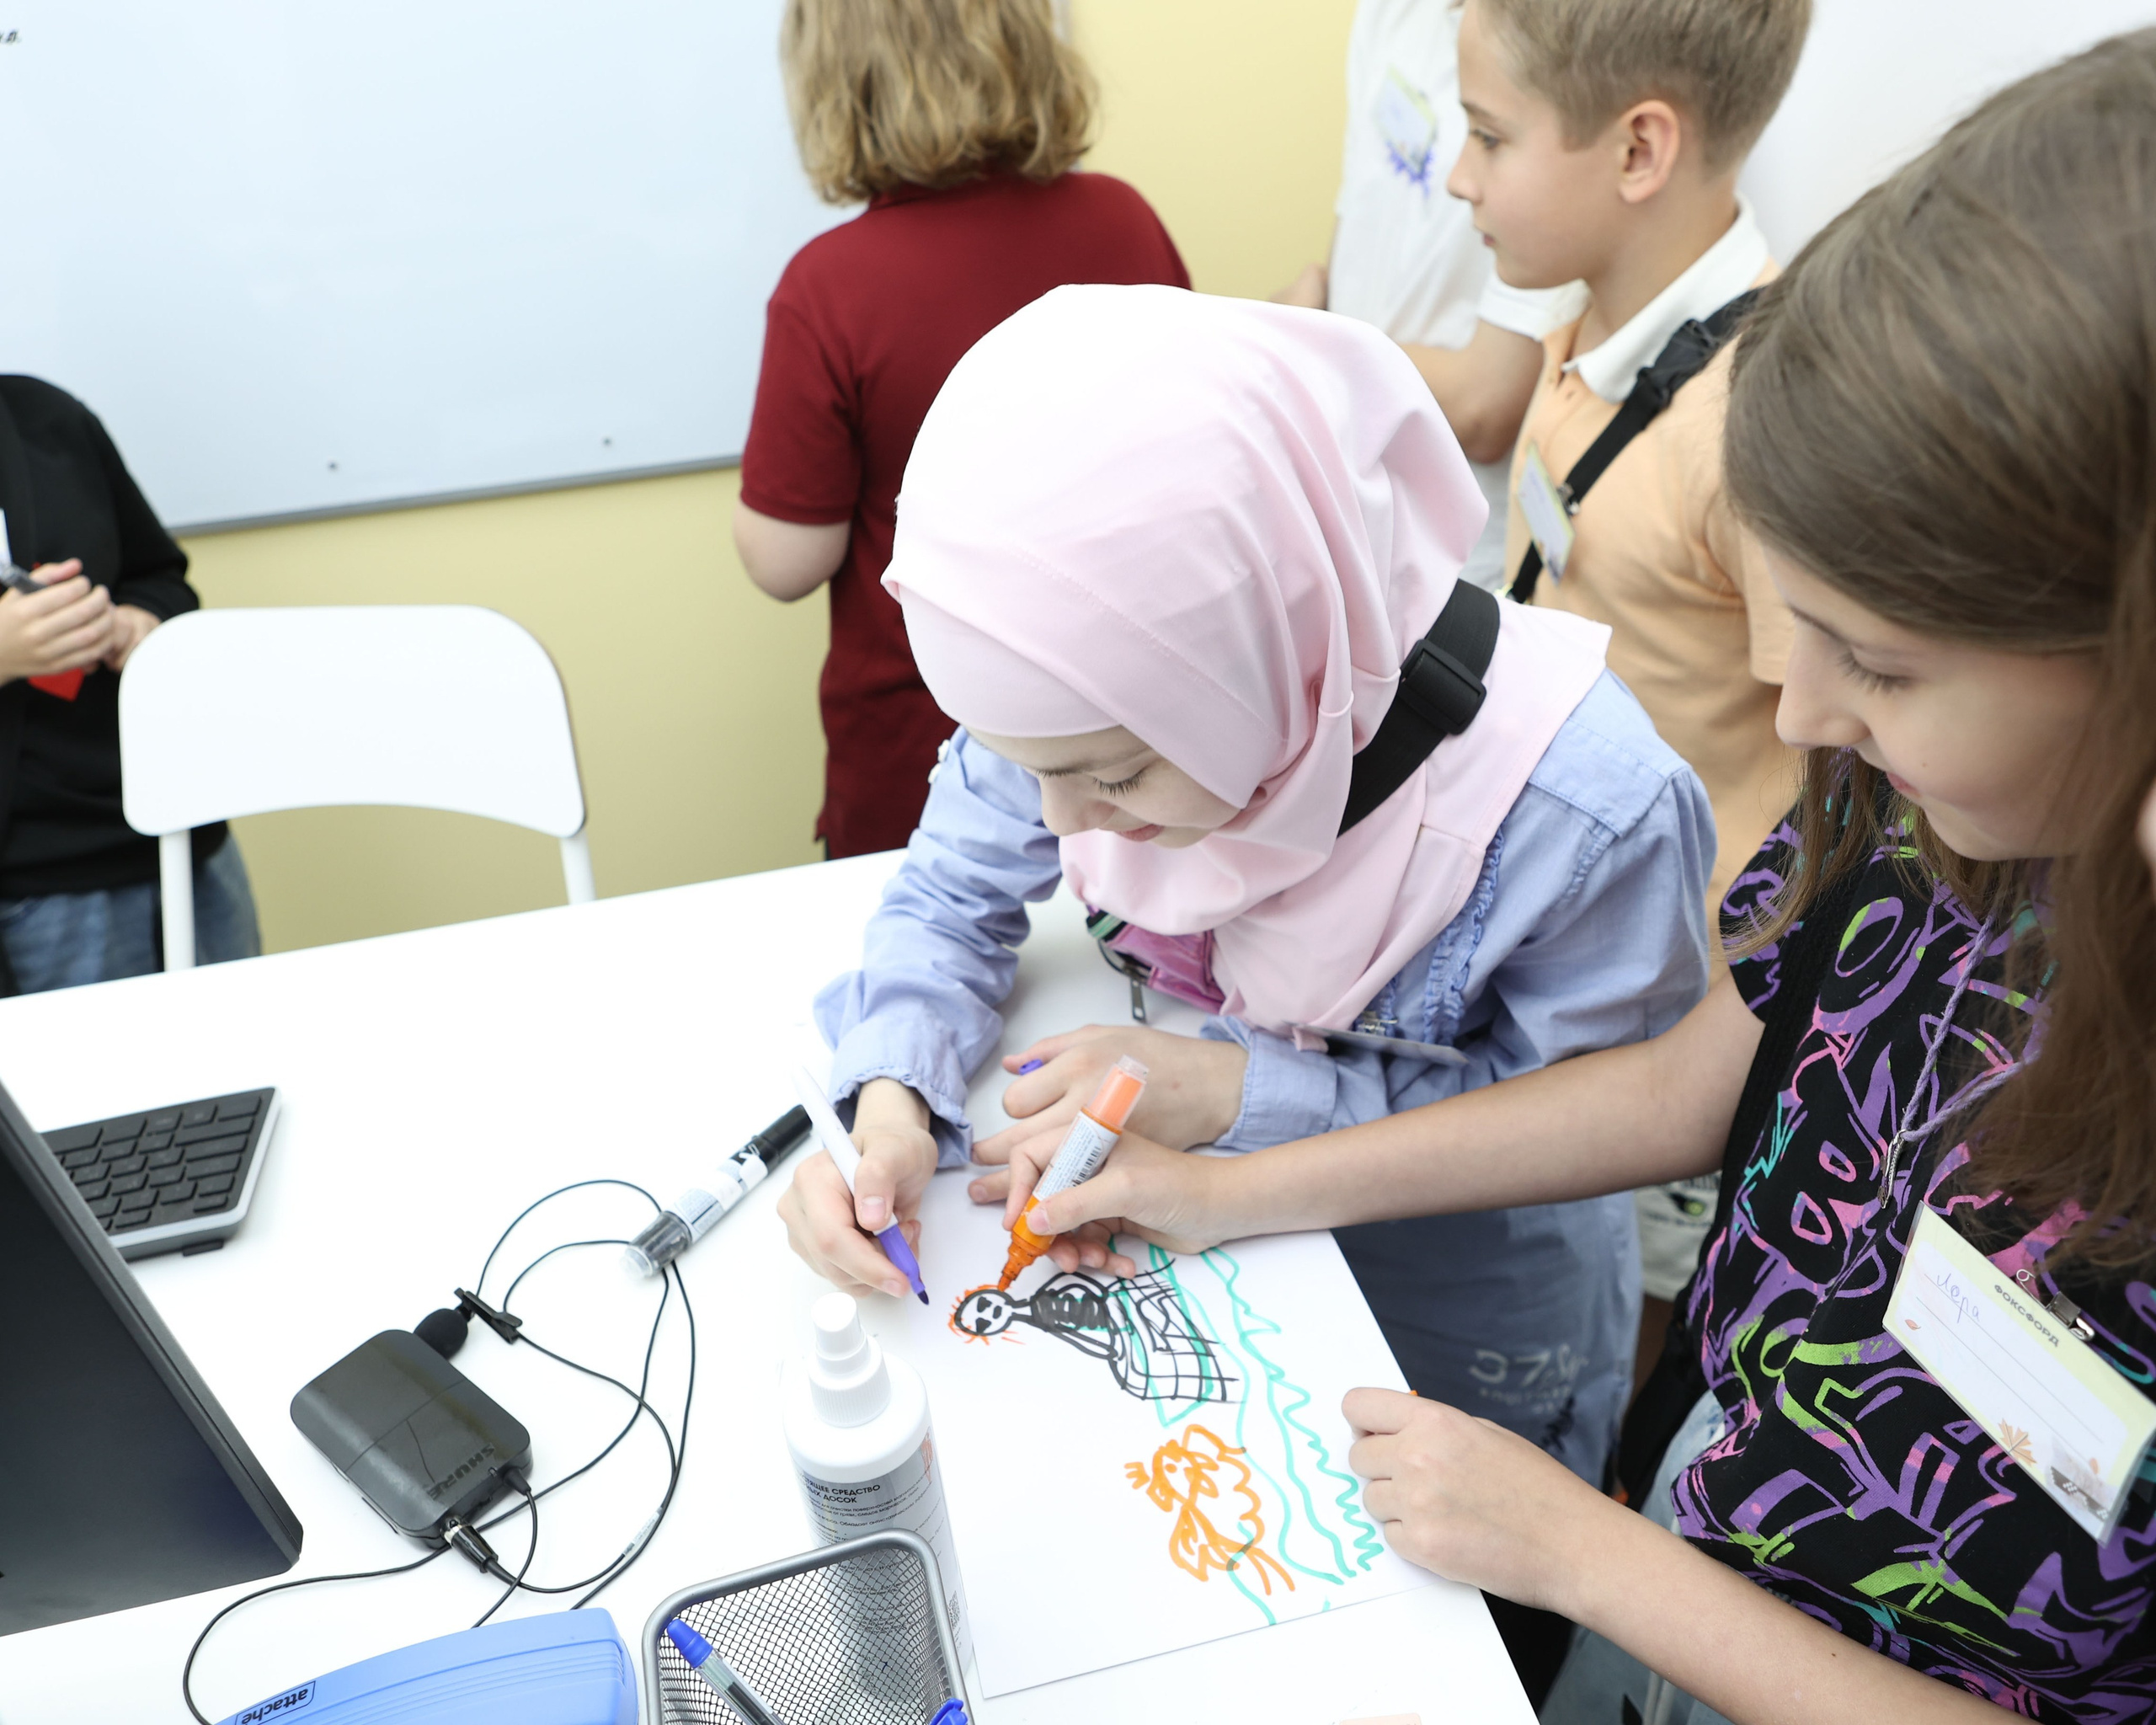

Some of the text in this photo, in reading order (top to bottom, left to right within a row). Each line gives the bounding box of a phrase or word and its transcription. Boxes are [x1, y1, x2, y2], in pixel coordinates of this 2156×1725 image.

[1993, 1284, 2060, 1348] ФОКСФОРД
[426, 1442, 495, 1502] SHURE
[824, 1493, 857, 1503] ДОСОК
[831, 1484, 881, 1497] СРЕДСТВО
